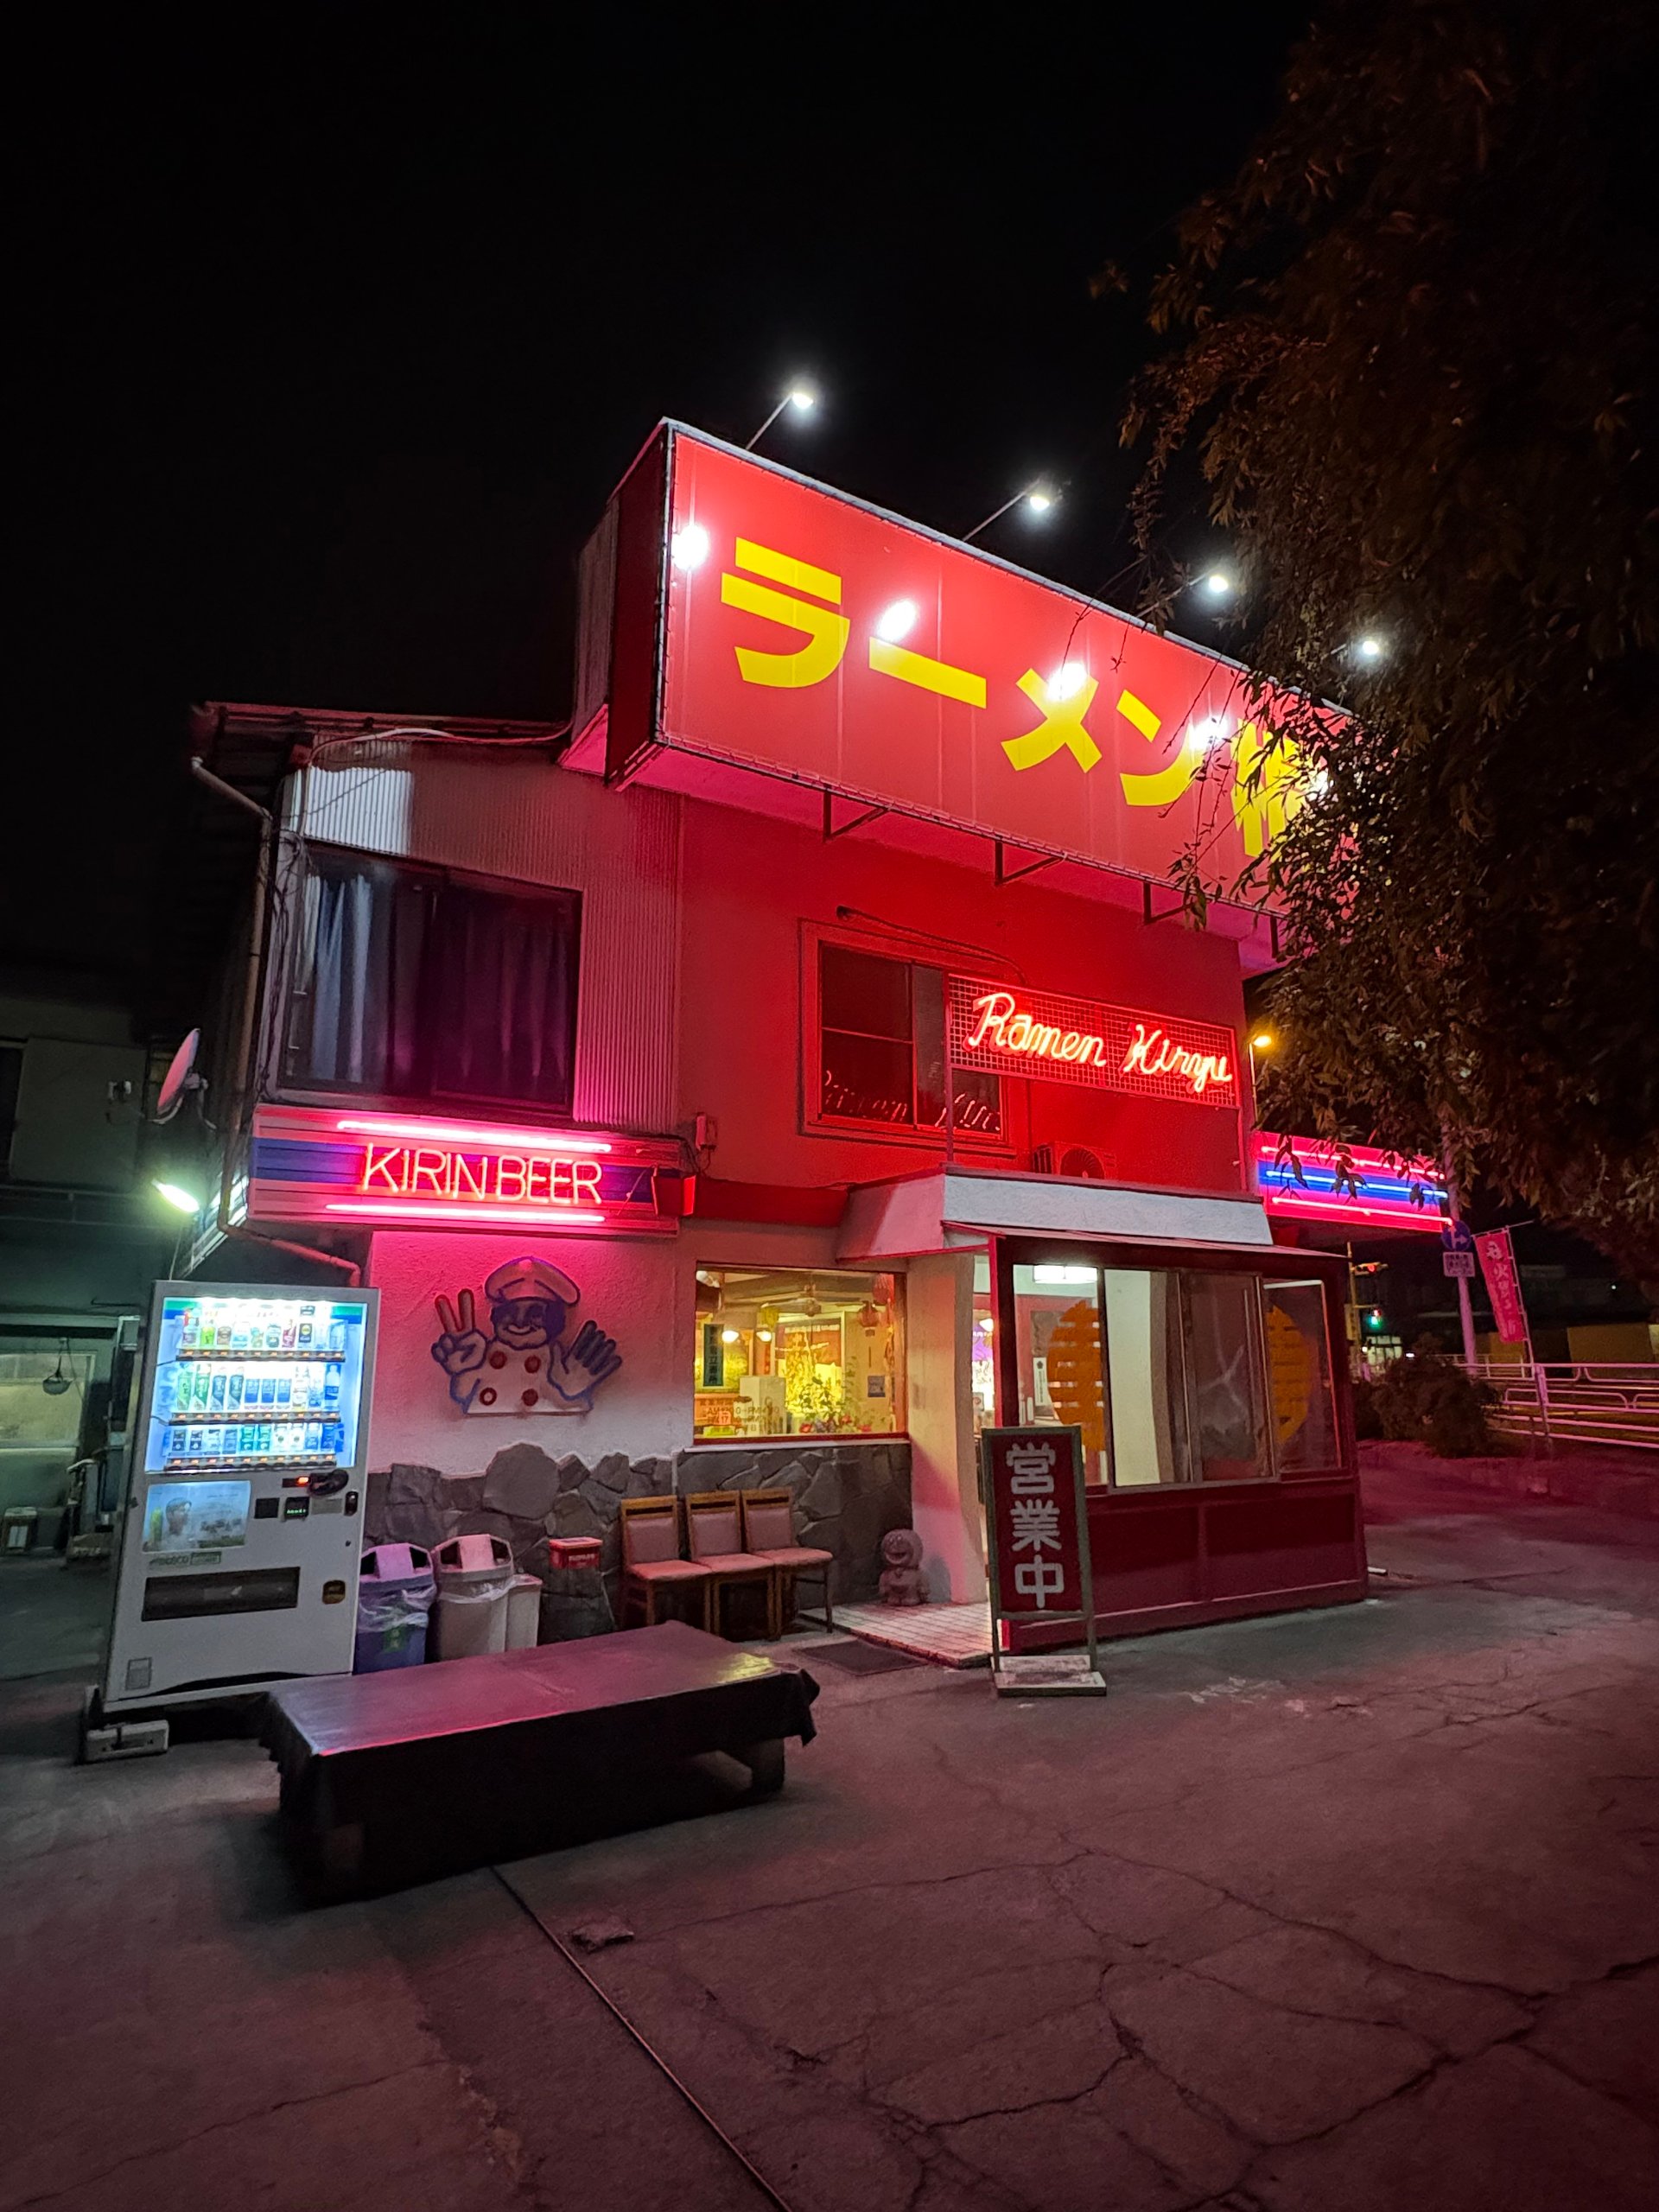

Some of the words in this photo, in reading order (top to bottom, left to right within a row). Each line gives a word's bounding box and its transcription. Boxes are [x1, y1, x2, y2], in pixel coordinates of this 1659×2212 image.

[968, 992, 1107, 1066] Ramen
[364, 1142, 488, 1198] KIRIN
[495, 1154, 603, 1205] BEER
[1007, 1442, 1065, 1609] 営業中
